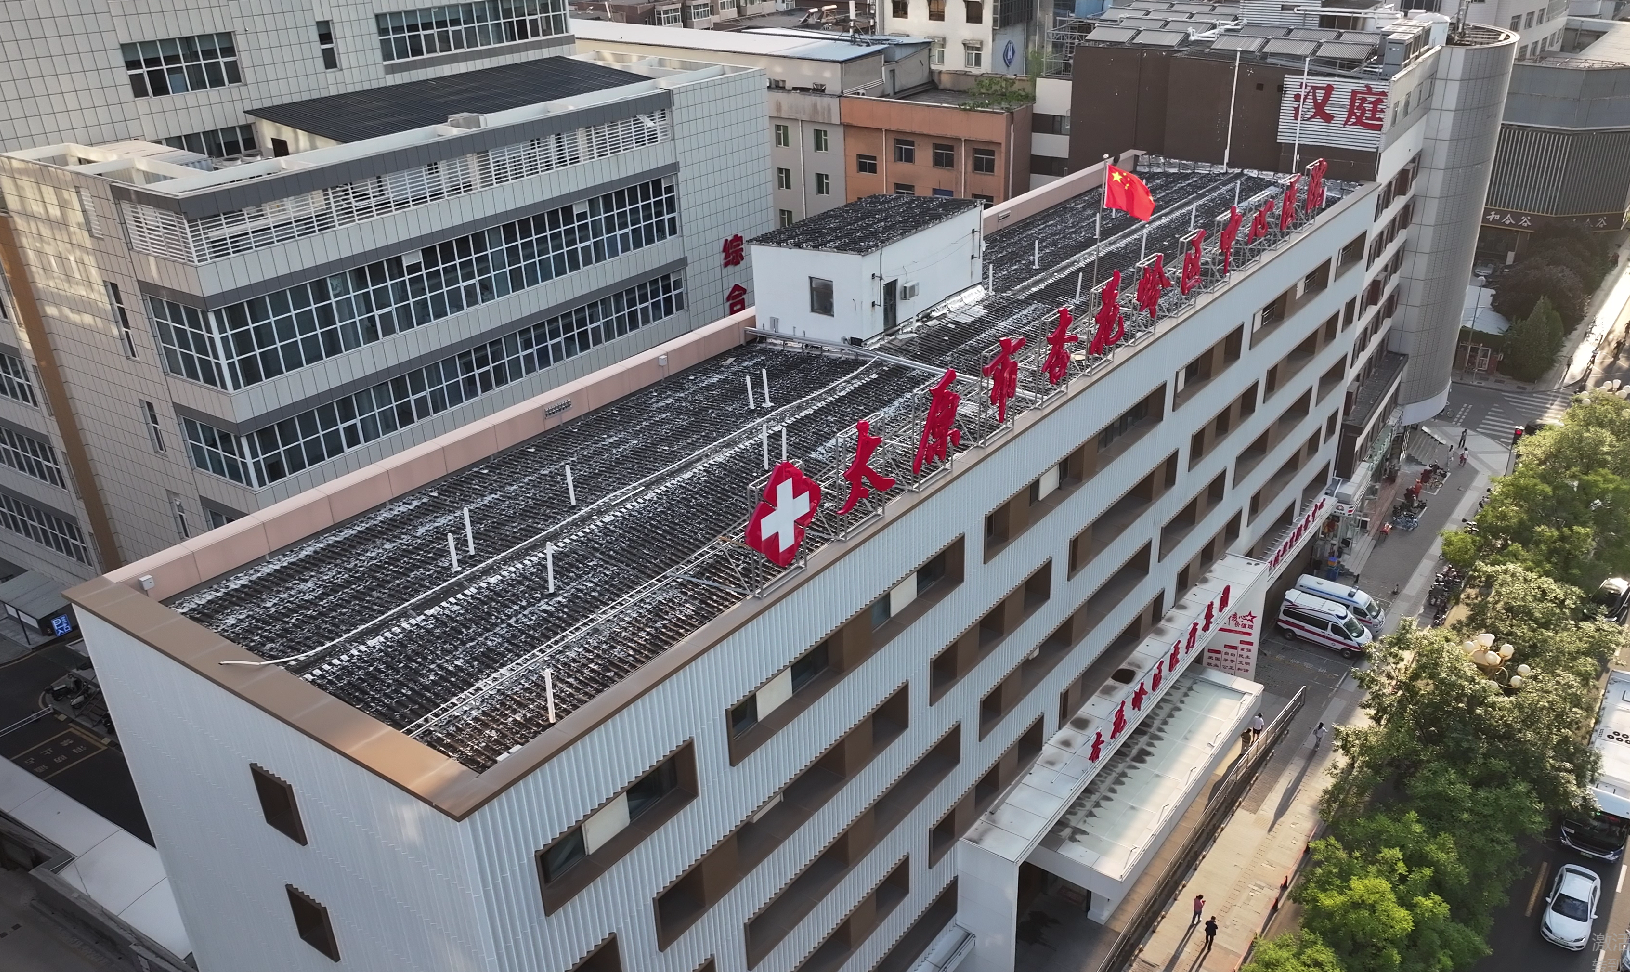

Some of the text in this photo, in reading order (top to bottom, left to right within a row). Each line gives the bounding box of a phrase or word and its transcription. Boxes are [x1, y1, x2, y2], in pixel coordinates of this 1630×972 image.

[1293, 83, 1389, 131] 汉庭
[1486, 210, 1532, 227] 和合谷
[722, 233, 747, 316] 综合
[836, 157, 1328, 516] 太原市杏花岭区中心医院
